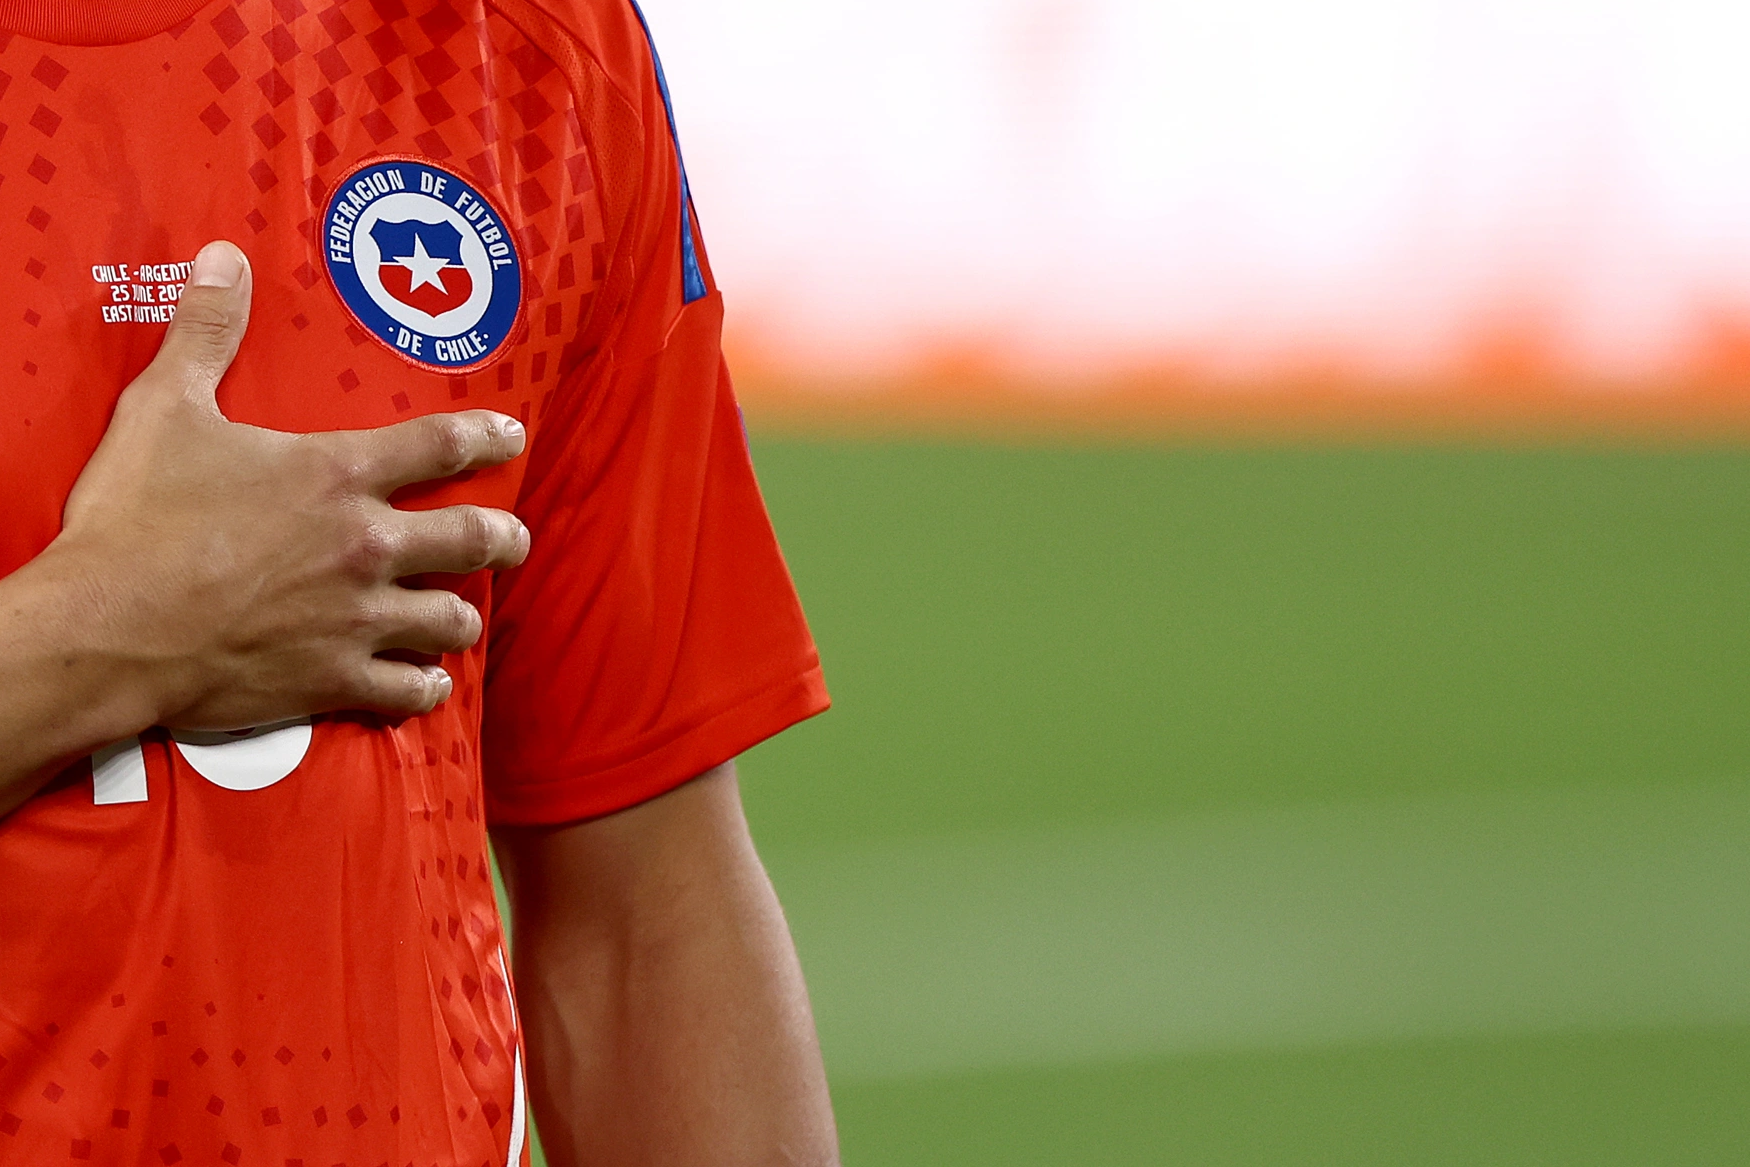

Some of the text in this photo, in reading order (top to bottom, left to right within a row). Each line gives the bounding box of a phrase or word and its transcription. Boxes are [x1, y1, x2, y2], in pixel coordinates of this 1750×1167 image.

[330, 169, 513, 270] FEDERACION DE FUTBOL
[91, 264, 130, 283] CHILE
[140, 261, 195, 282] ARGENTI
[110, 284, 130, 302] 25
[158, 284, 185, 302] 202
[102, 304, 176, 323] EAST RUTHER
[396, 327, 488, 362] DE CHILE
